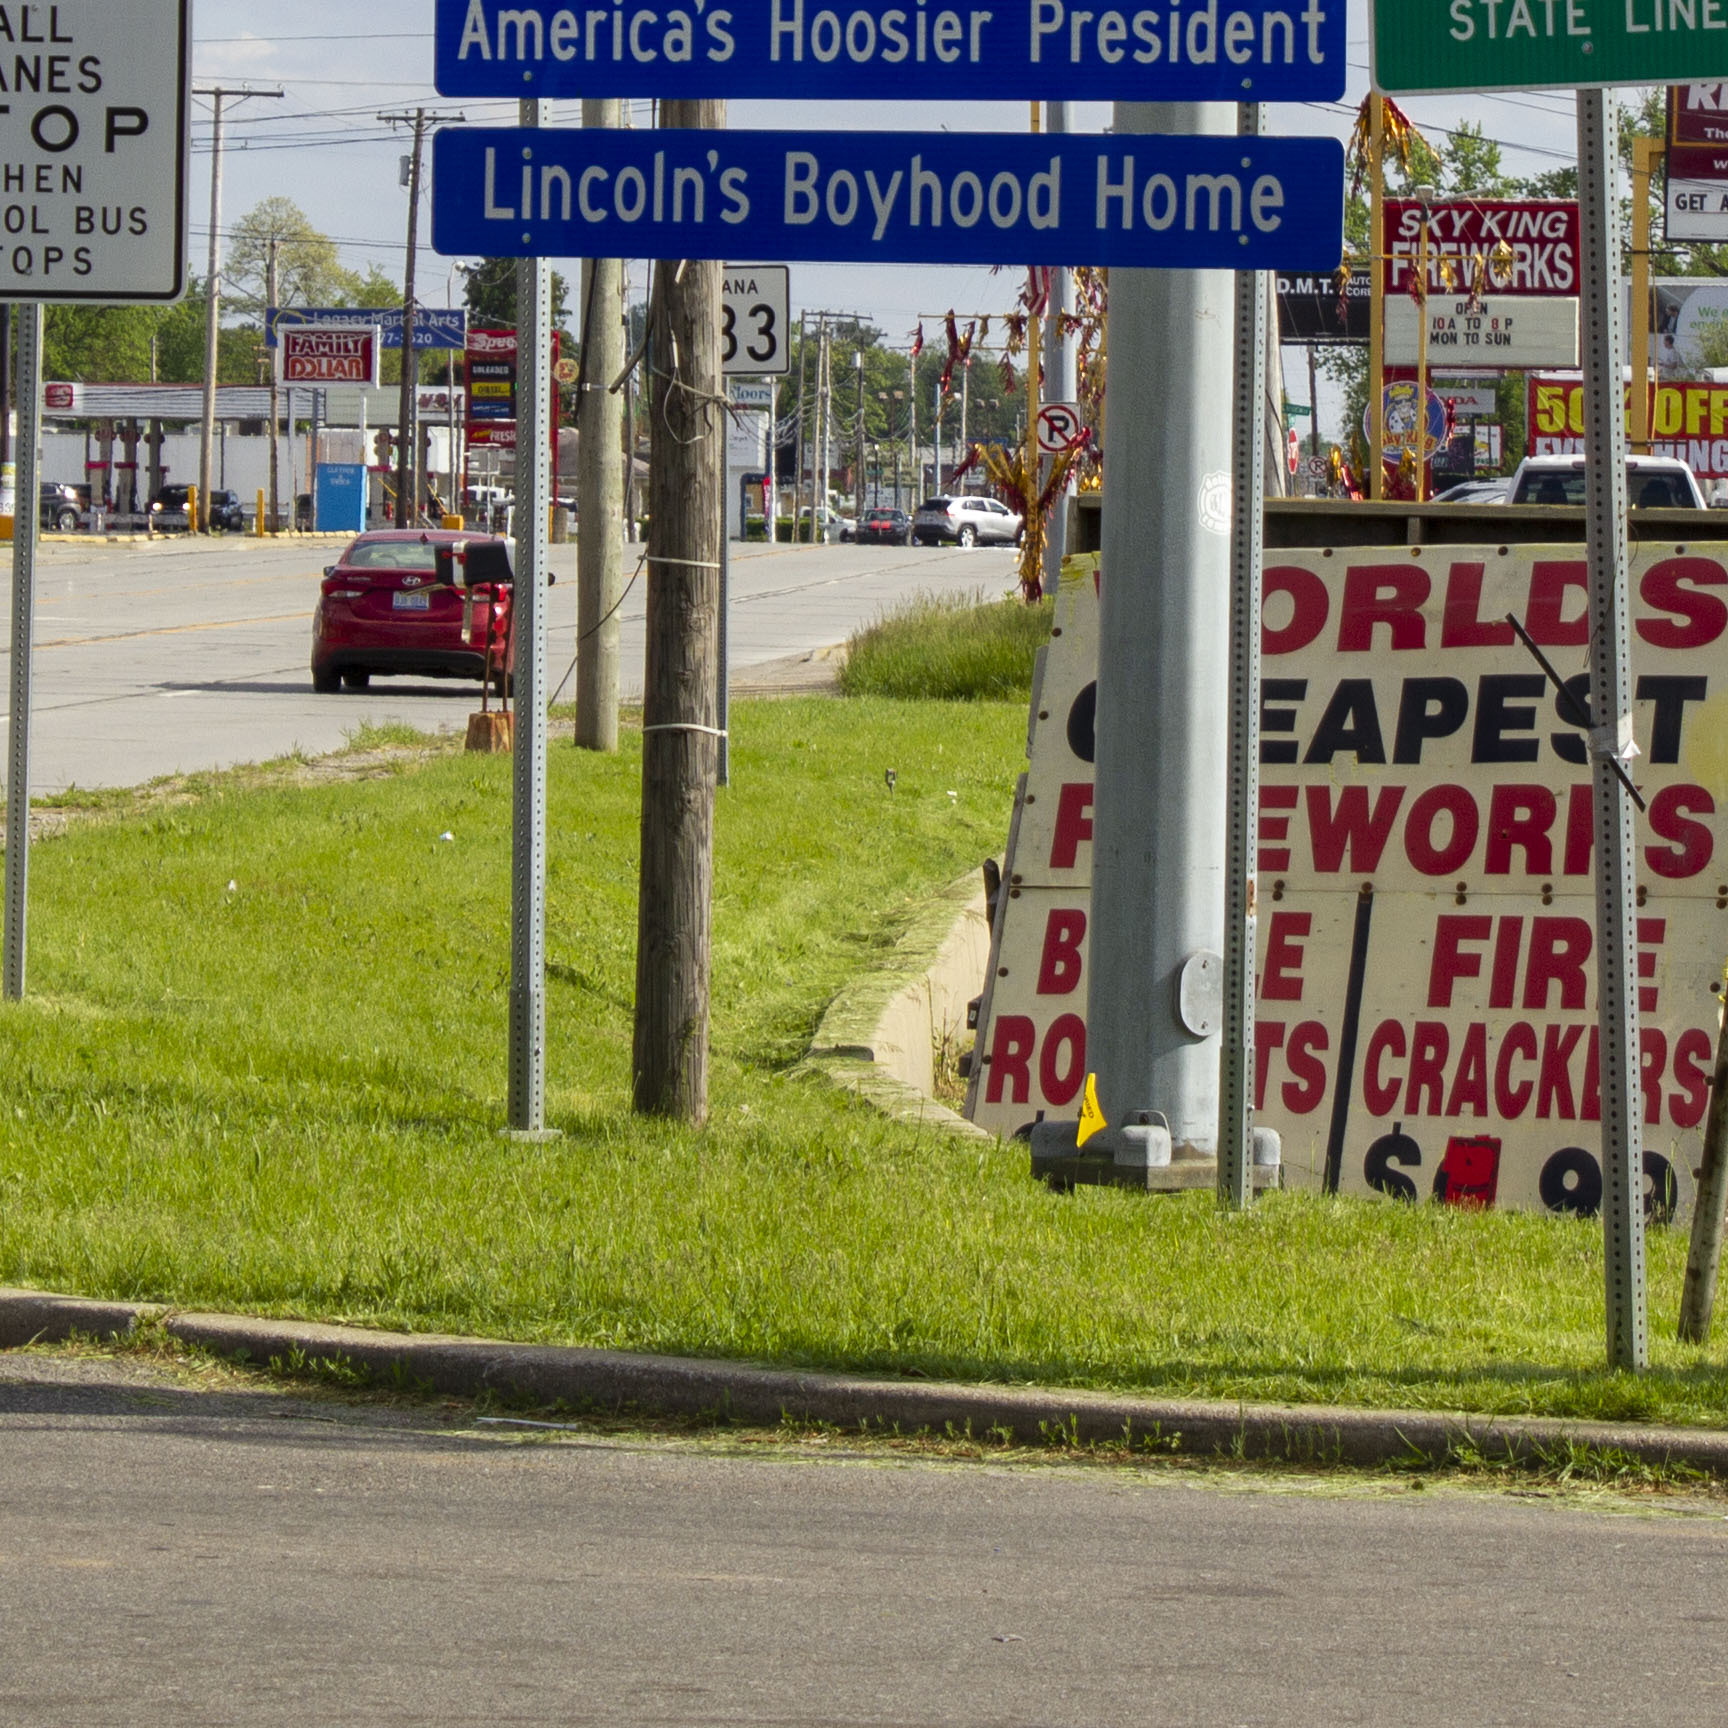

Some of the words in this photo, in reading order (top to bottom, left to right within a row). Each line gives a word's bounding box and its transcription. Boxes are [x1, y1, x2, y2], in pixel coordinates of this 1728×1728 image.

[483, 146, 750, 225] Lincoln's
[784, 151, 1062, 241] Boyhood
[1096, 155, 1285, 233] Home
[1675, 192, 1708, 212] GET
[74, 206, 148, 236] BUS
[1398, 208, 1473, 238] SKY
[1480, 210, 1569, 239] KING
[1392, 241, 1574, 290] FIREWORKS
[1277, 277, 1334, 295] D.M.T.
[374, 312, 427, 327] Martal
[428, 314, 460, 327] Arts
[1456, 302, 1488, 315] OPEN
[1465, 318, 1481, 330] TO
[1505, 318, 1513, 330] P
[289, 331, 364, 355] FAMILY
[1429, 332, 1458, 345] MON
[1464, 333, 1480, 345] TO
[1485, 333, 1512, 345] SUN
[288, 357, 364, 379] DOLLAR
[1067, 674, 1708, 765] EAPEST
[1049, 783, 1715, 879] FEWORS
[1427, 914, 1666, 1010] FIRE
[985, 1013, 1328, 1114] ROTS
